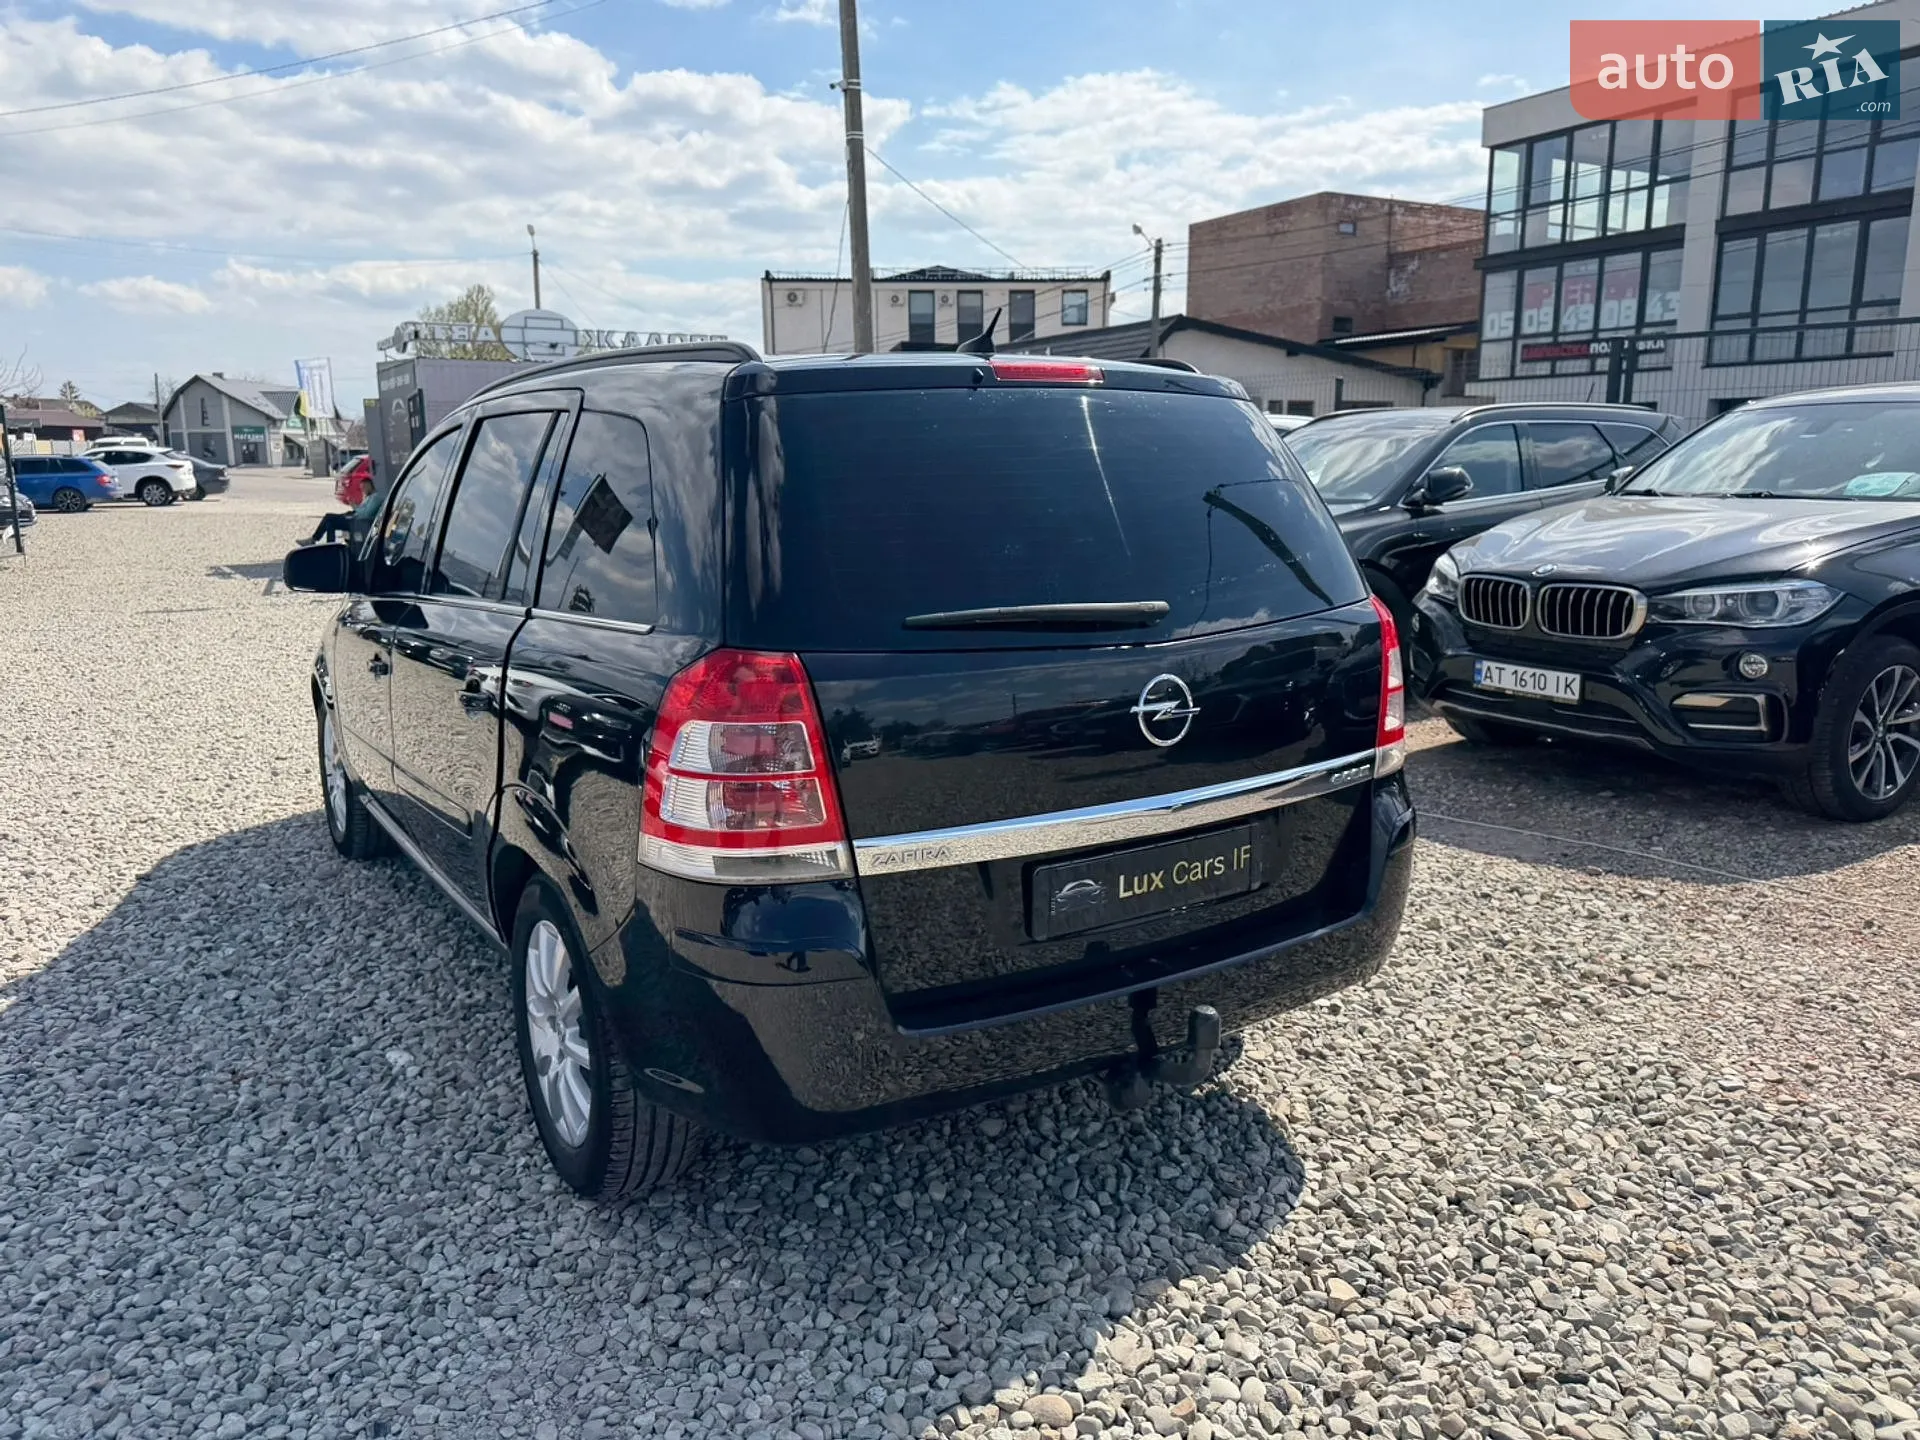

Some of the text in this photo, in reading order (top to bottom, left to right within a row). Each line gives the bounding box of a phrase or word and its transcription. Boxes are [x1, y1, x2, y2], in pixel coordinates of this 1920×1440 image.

[1483, 665, 1506, 684] AT
[1511, 669, 1547, 691] 1610
[1555, 675, 1577, 697] IK
[871, 845, 953, 866] ZAFIRA
[1118, 844, 1252, 899] Lux Cars IF
